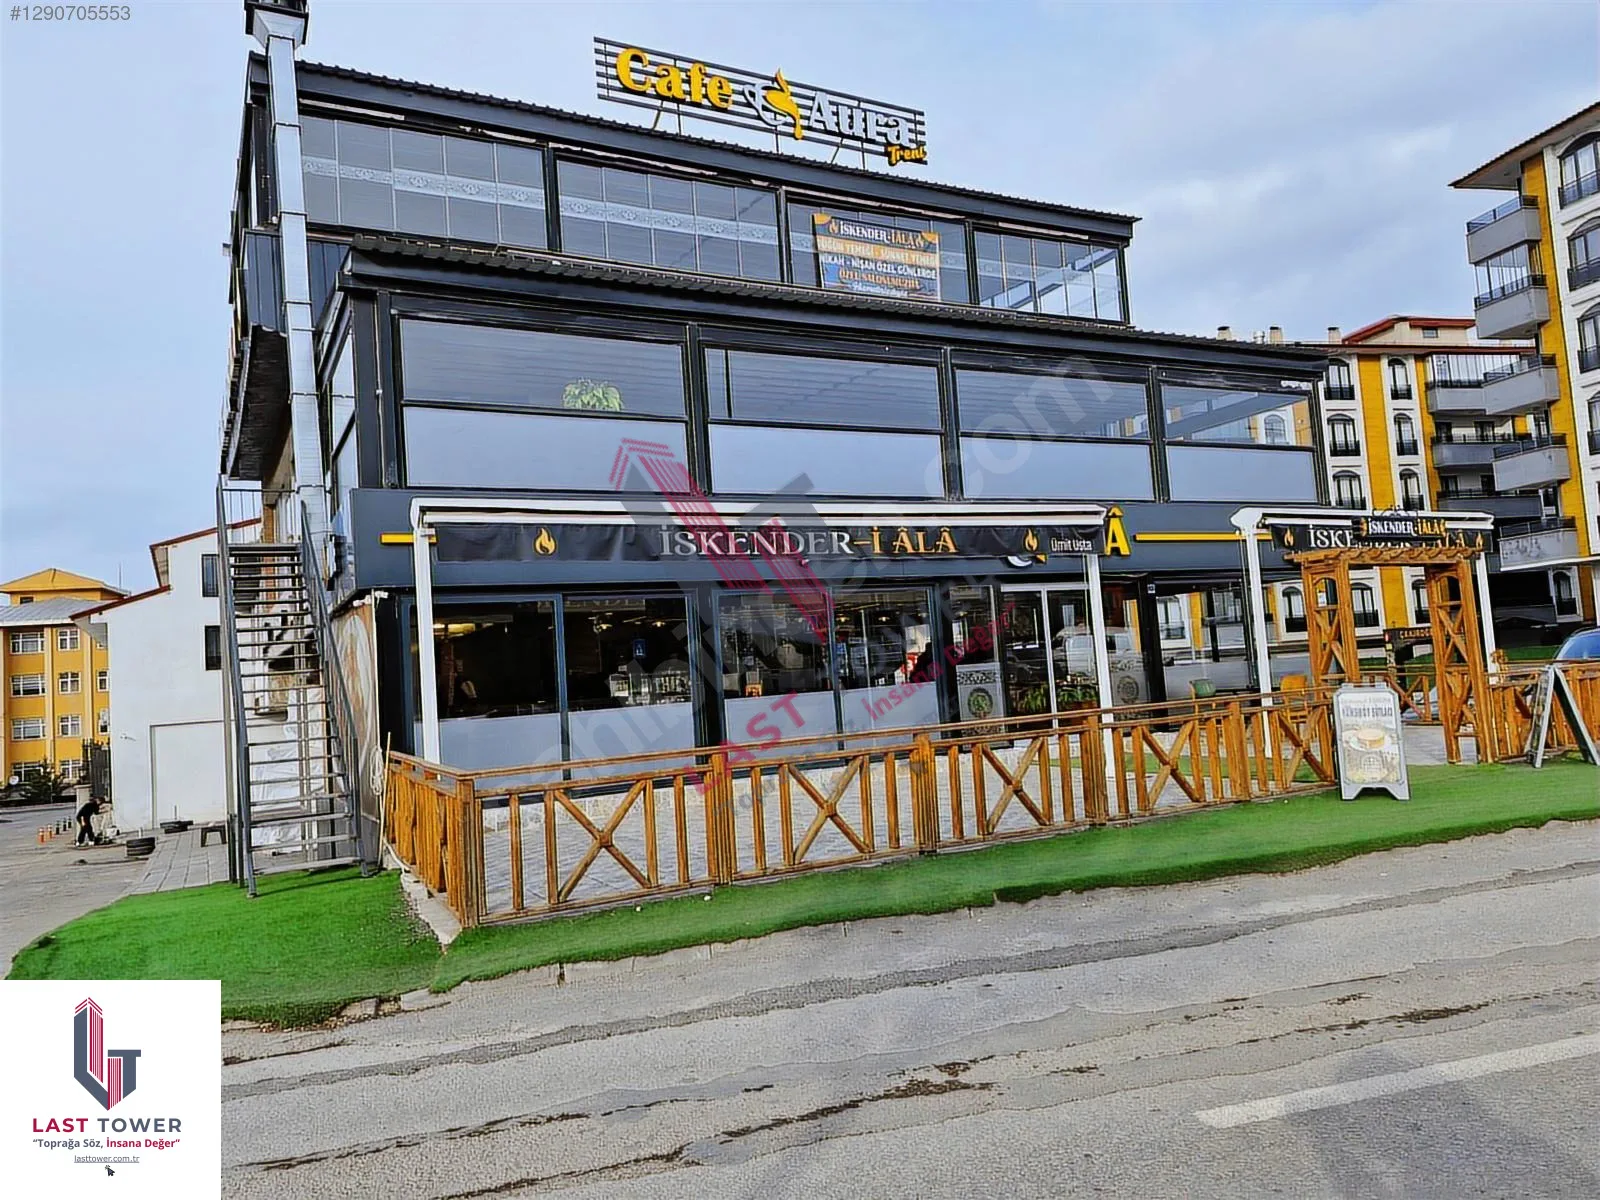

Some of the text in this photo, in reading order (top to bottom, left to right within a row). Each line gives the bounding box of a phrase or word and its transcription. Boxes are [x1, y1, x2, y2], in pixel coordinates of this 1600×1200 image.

[616, 47, 918, 148] Cafe Aura
[891, 526, 959, 555] ÂLÂ
